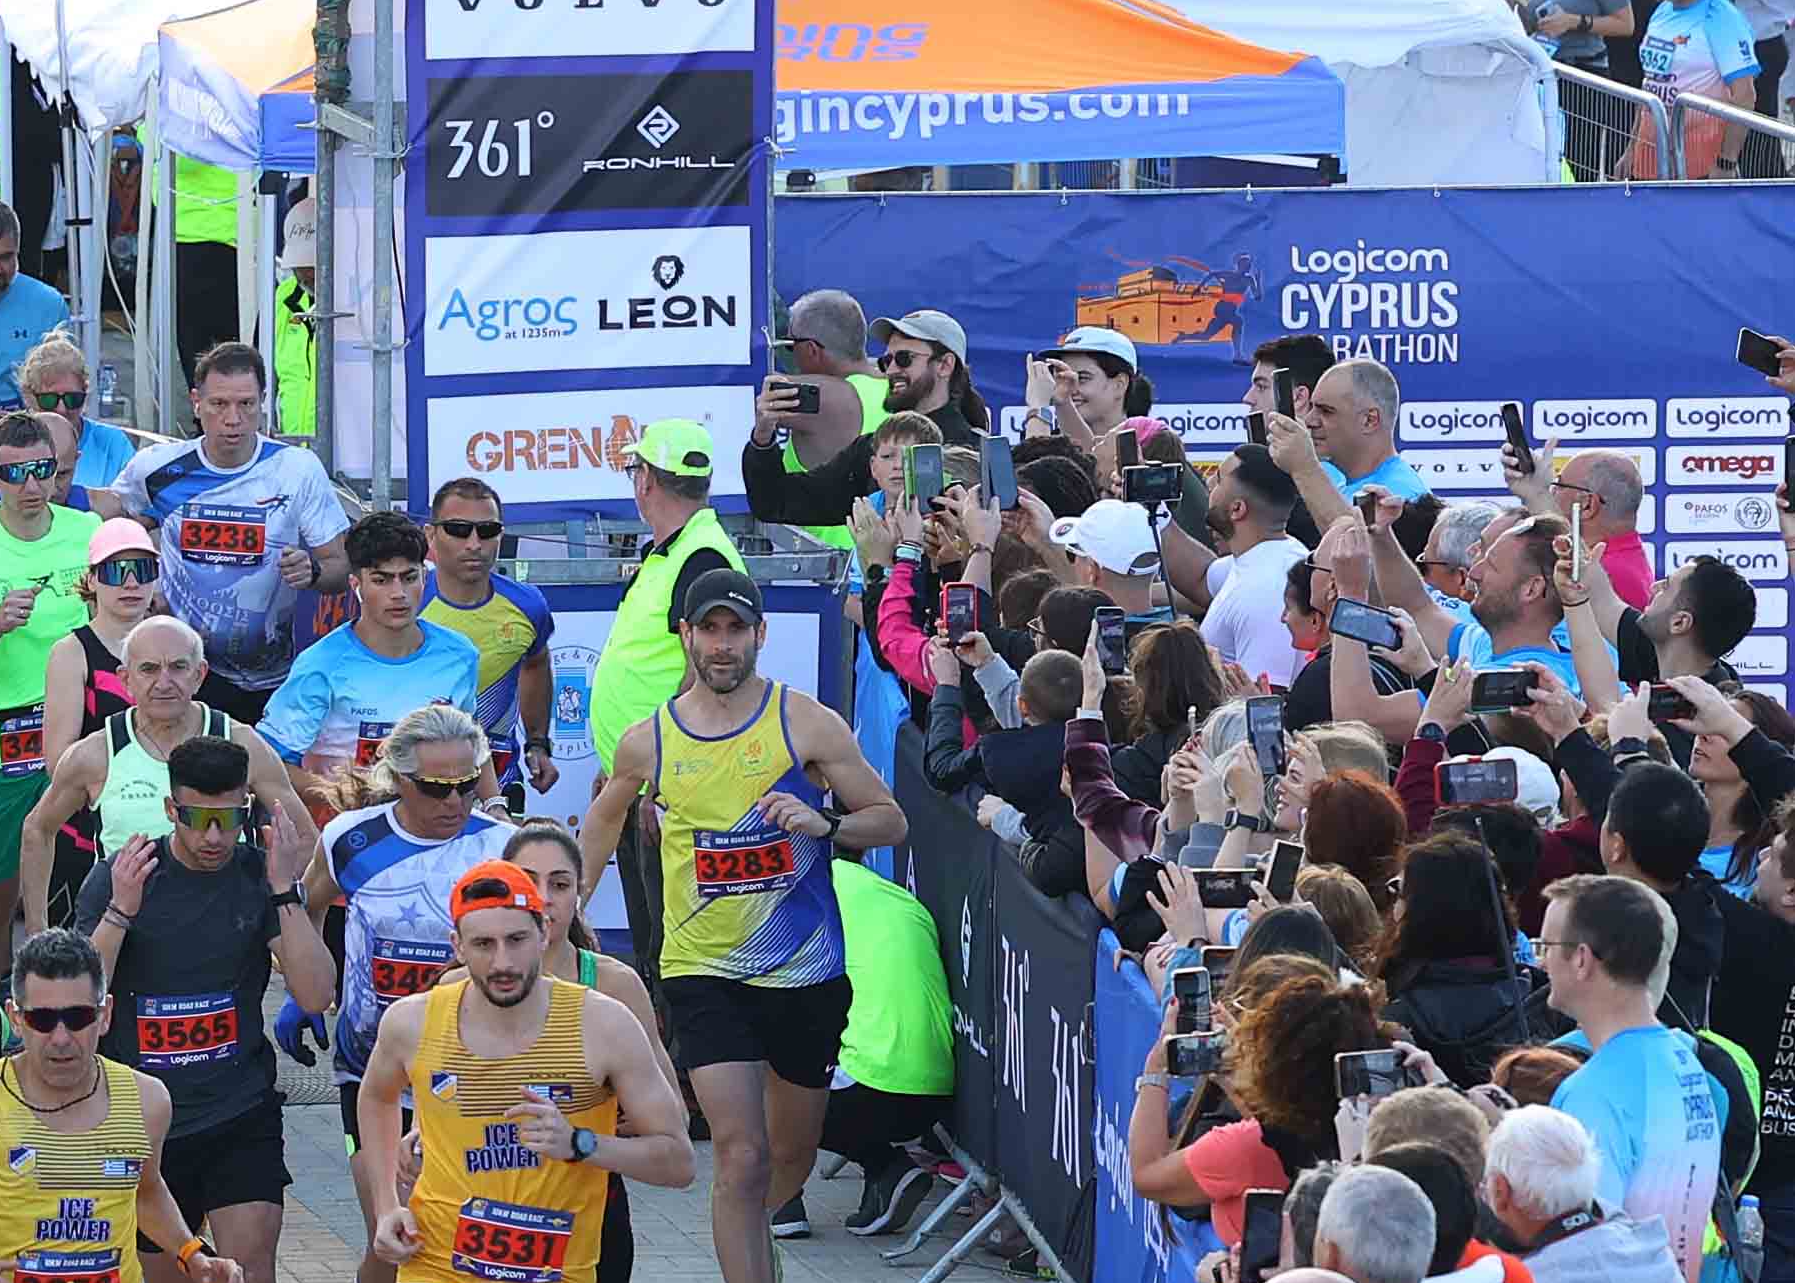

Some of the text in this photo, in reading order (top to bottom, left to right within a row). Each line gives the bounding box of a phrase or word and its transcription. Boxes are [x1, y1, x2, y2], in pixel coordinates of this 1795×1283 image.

[582, 154, 736, 173] RONHILL
[1290, 239, 1449, 283] Logicom
[597, 295, 737, 331] LEON
[1280, 281, 1459, 329] CYPRUS
[504, 327, 562, 340] at 1235m
[1289, 333, 1459, 364] RATHON
[1541, 402, 1648, 433] Logicom
[1674, 401, 1783, 432] Logicom
[1408, 461, 1496, 475] VOLV
[1681, 453, 1776, 478] omega
[186, 524, 258, 549] 3238
[205, 553, 237, 564] Logicom
[701, 845, 785, 879] 3283
[726, 881, 765, 894] Logicom
[144, 1014, 232, 1050] 3565
[169, 1053, 210, 1067] Logicom
[484, 1122, 518, 1149] ICE
[465, 1147, 540, 1173] POWER
[57, 1196, 95, 1221] ICE
[35, 1219, 111, 1243] POWER
[462, 1225, 556, 1264] 3531
[484, 1267, 527, 1281] Logicom
